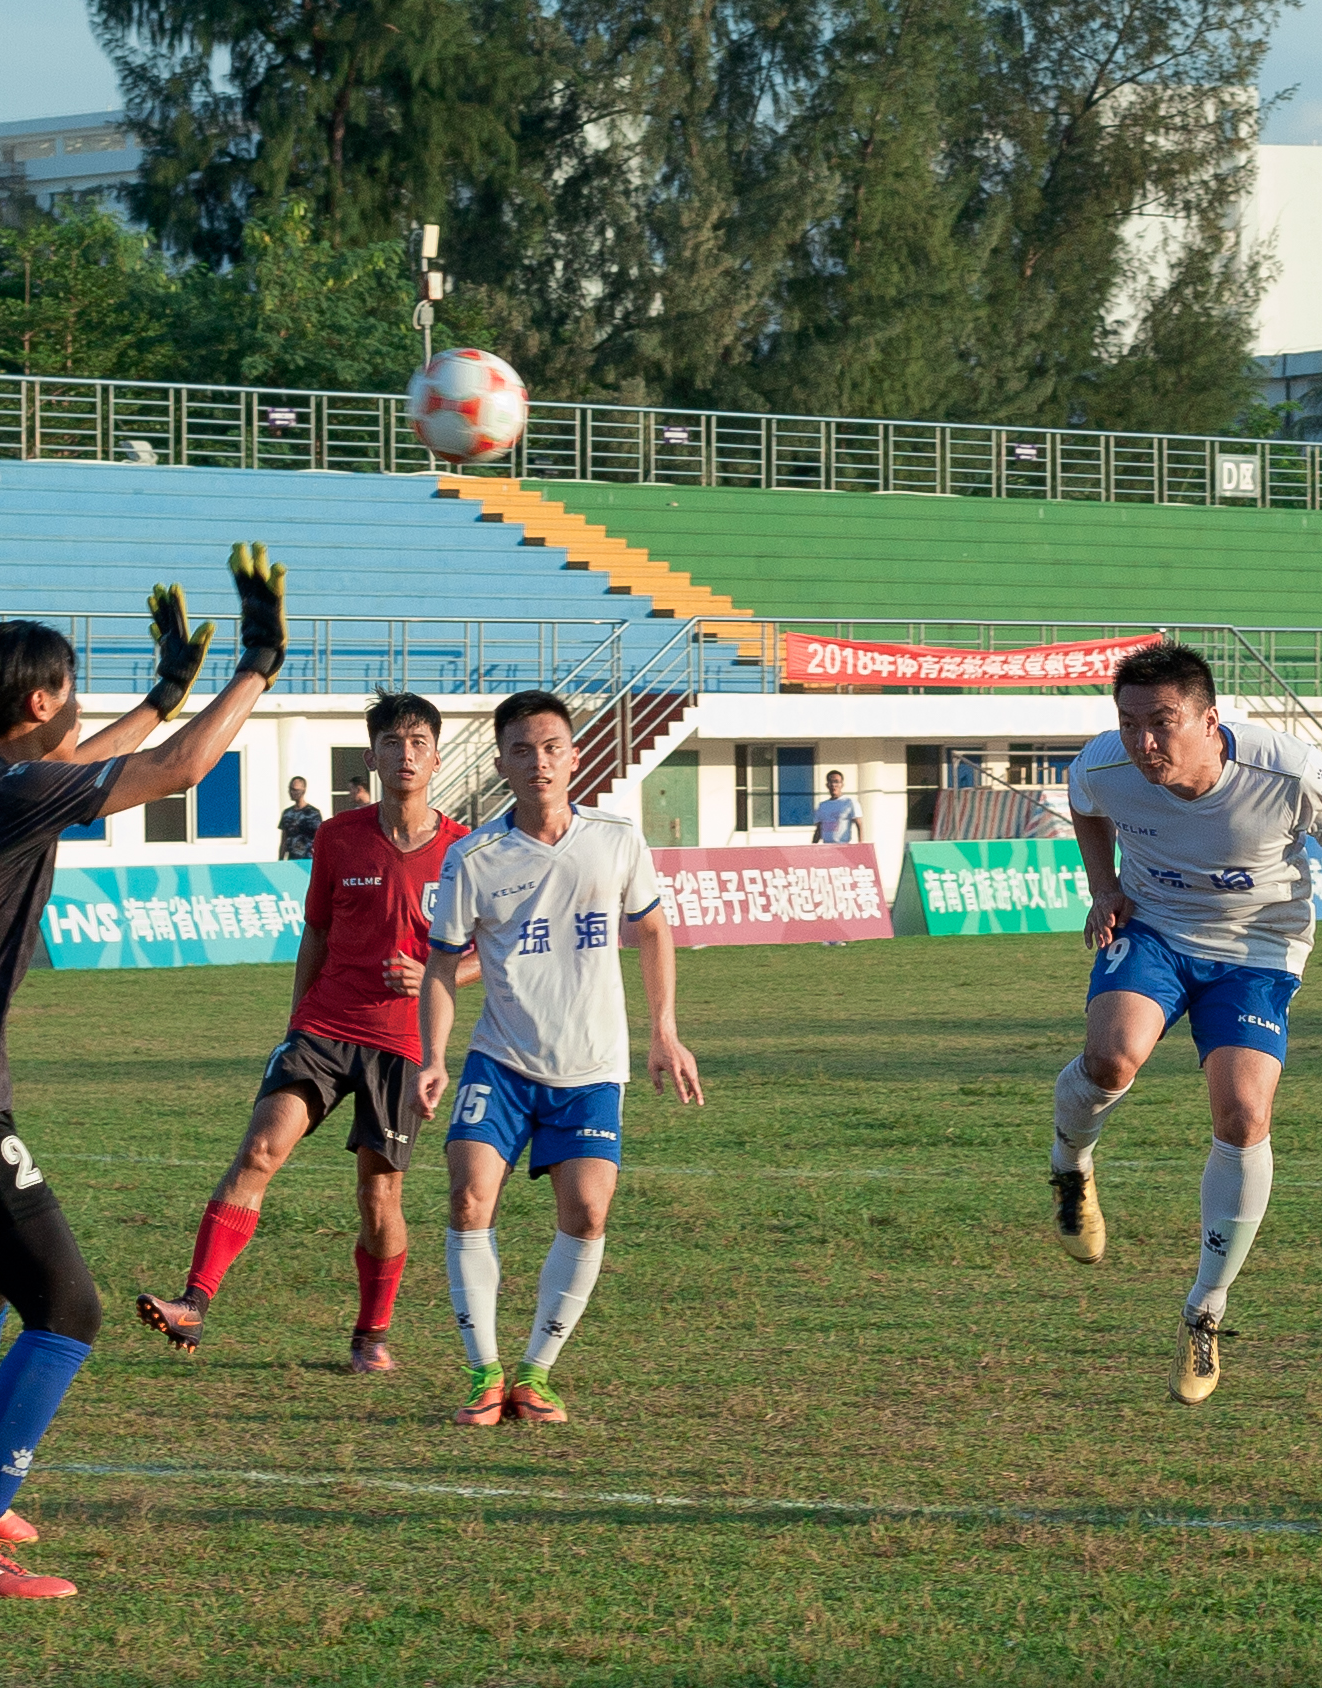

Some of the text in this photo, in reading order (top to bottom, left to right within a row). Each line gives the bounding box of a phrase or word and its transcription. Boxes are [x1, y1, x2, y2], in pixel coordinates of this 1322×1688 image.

[342, 877, 382, 886] KELME
[491, 881, 536, 899] KELME
[654, 864, 882, 927] 南省男子足球超级联赛
[519, 911, 607, 956] 琼海
[1105, 937, 1130, 974] 9
[1238, 1014, 1281, 1035] KELME
[452, 1083, 493, 1125] 15
[576, 1128, 617, 1141] KELME
[1, 1135, 43, 1190] 2
